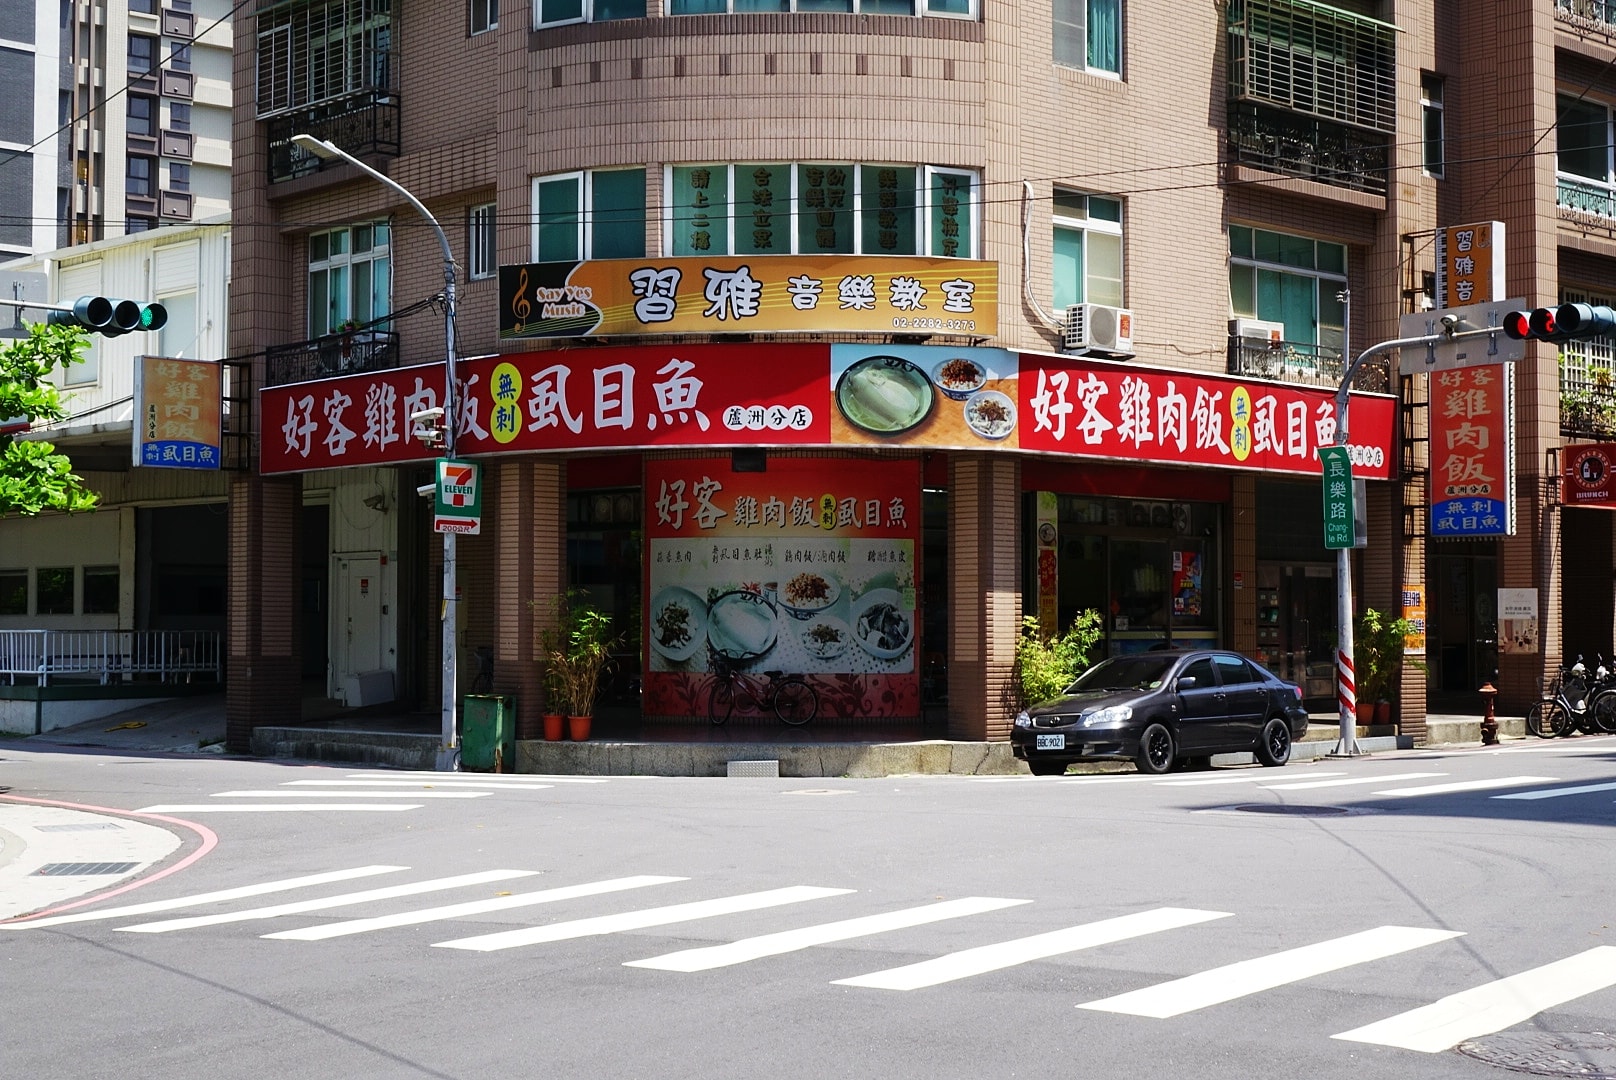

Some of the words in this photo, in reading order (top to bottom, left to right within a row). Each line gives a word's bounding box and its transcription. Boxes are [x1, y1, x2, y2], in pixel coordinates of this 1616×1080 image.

[690, 168, 711, 250] 請上二樓
[752, 168, 773, 249] 合法立案
[537, 286, 565, 303] Say
[564, 285, 592, 301] Yes
[541, 301, 586, 319] Music
[892, 316, 976, 332] 02-2282-3273
[155, 361, 210, 380] 好客
[1438, 368, 1494, 387] 好客
[496, 372, 516, 434] 無刺
[528, 358, 711, 434] 虱目魚
[725, 406, 807, 431] 蘆洲分店
[160, 380, 206, 441] 雞肉飯
[1029, 367, 1230, 455] 好客雞肉飯
[1440, 388, 1497, 482] 雞肉飯
[163, 445, 215, 464] 虱目魚
[446, 466, 473, 507] 7
[1329, 461, 1347, 519] 長樂路
[1445, 484, 1490, 494] 蘆洲分店
[1576, 490, 1609, 499] BRUNCH
[836, 496, 907, 529] 虱目魚
[1444, 499, 1492, 515] 無刺
[442, 525, 471, 533] 200公尺
[1328, 522, 1349, 533] Chang-
[1437, 514, 1501, 531] 虱目魚
